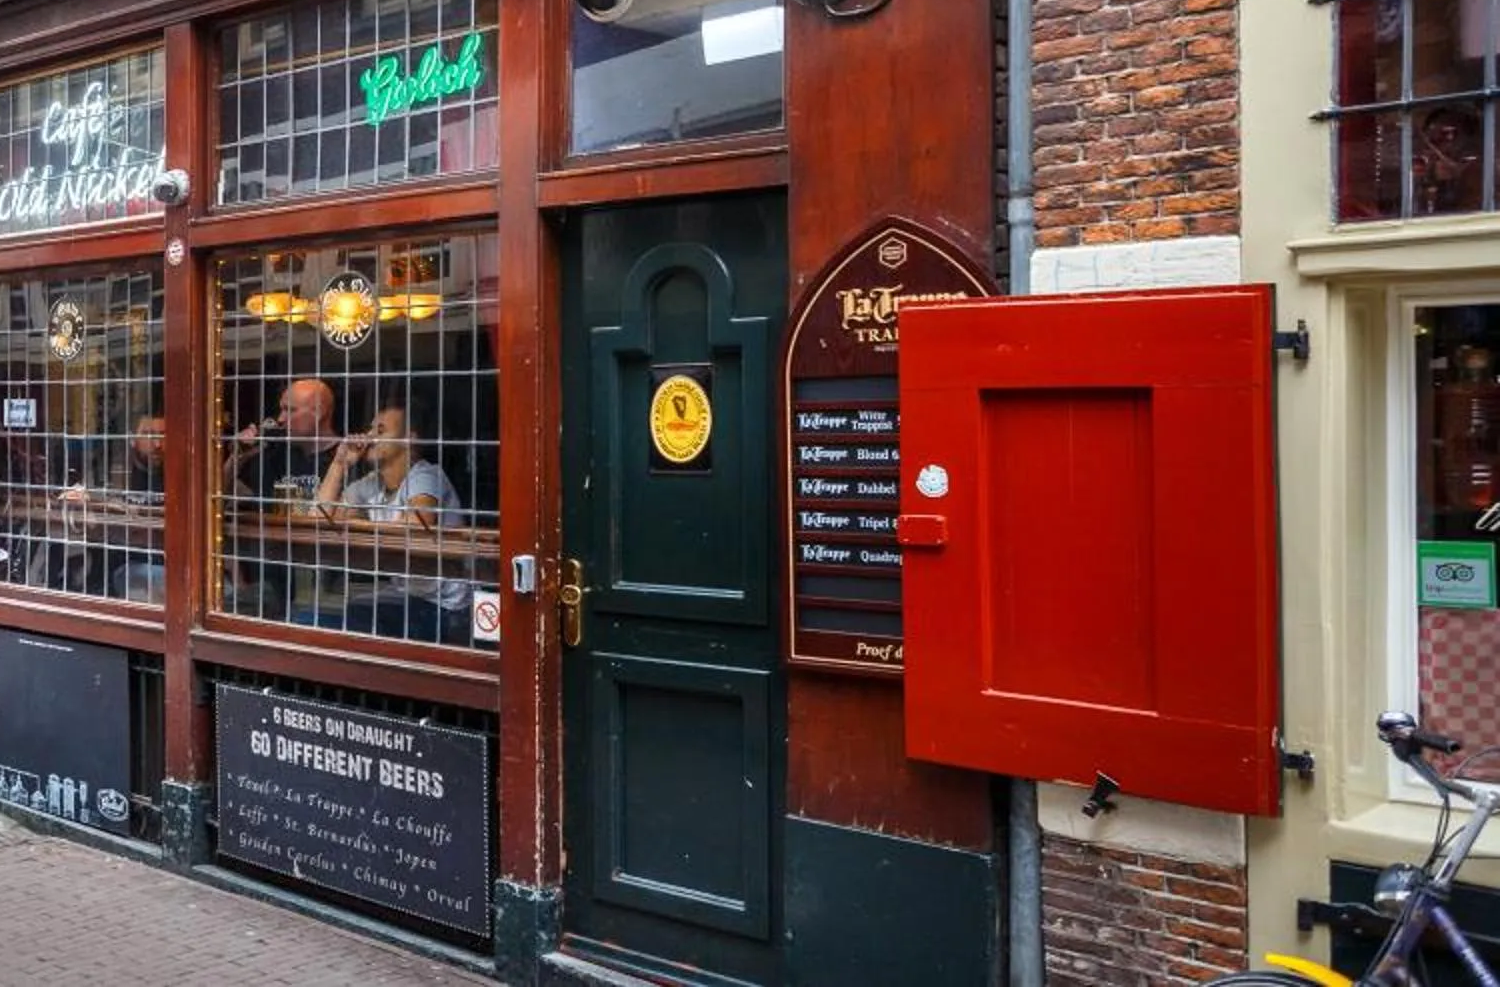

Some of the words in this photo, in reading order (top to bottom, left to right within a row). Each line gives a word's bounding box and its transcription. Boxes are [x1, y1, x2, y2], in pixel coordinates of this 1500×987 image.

[56, 143, 167, 213] Nickel
[858, 517, 889, 530] Tripel
[856, 642, 893, 661] Proef
[273, 706, 281, 724] 6
[283, 708, 322, 734] BEERS
[325, 719, 345, 740] ON
[347, 722, 415, 753] DRAUGHT
[251, 730, 271, 757] 60
[276, 735, 373, 782] DIFFERENT
[379, 759, 444, 799] BEERS
[353, 867, 407, 899] Chimay
[427, 888, 472, 912] Orval
